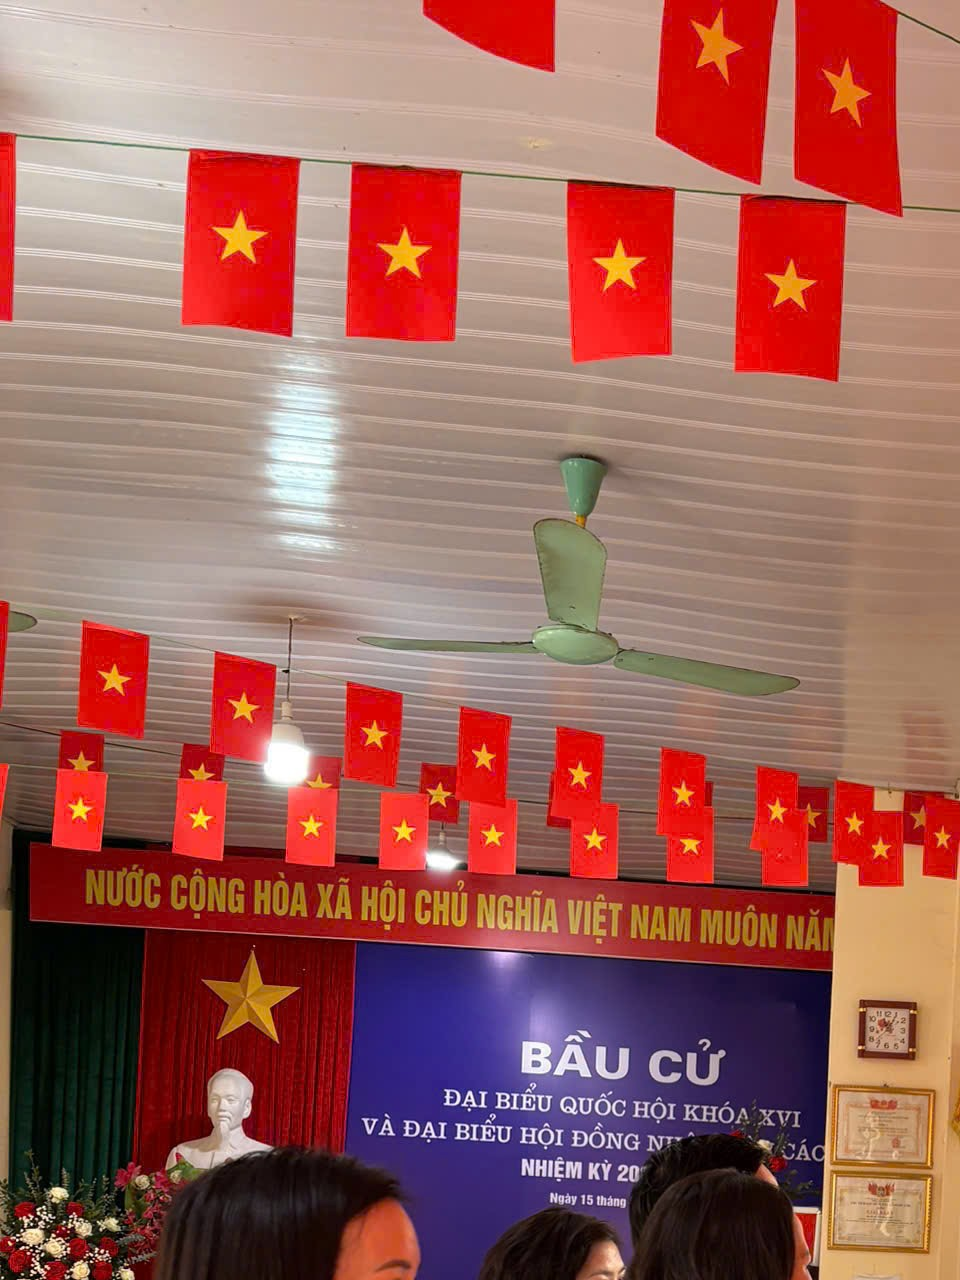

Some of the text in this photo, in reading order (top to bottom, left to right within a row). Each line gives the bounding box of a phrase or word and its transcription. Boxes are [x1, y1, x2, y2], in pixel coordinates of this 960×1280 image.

[85, 864, 161, 909] NƯỚC
[171, 868, 245, 919] CỘNG
[254, 872, 308, 918] HÒA
[316, 878, 352, 919] XÃ
[361, 880, 405, 930] HỘI
[415, 880, 467, 927] CHỦ
[477, 890, 558, 933] NGHĨA
[567, 894, 623, 944] VIỆT
[630, 905, 691, 942] NAM
[700, 905, 777, 948] MUÔN
[521, 1029, 727, 1086] BẦU CỬ
[443, 1082, 801, 1128] ĐẠI BIỂU QUỐC HỘI KHÓA XVI
[361, 1113, 395, 1137] VÀ
[403, 1119, 447, 1143] ĐẠI
[454, 1113, 512, 1143] BIỂU
[520, 1122, 563, 1150] HỘI
[571, 1122, 641, 1151] ĐỒNG
[521, 1156, 643, 1182] NHIỆM KỲ 20
[549, 1192, 627, 1209] Ngày 15 tháng
